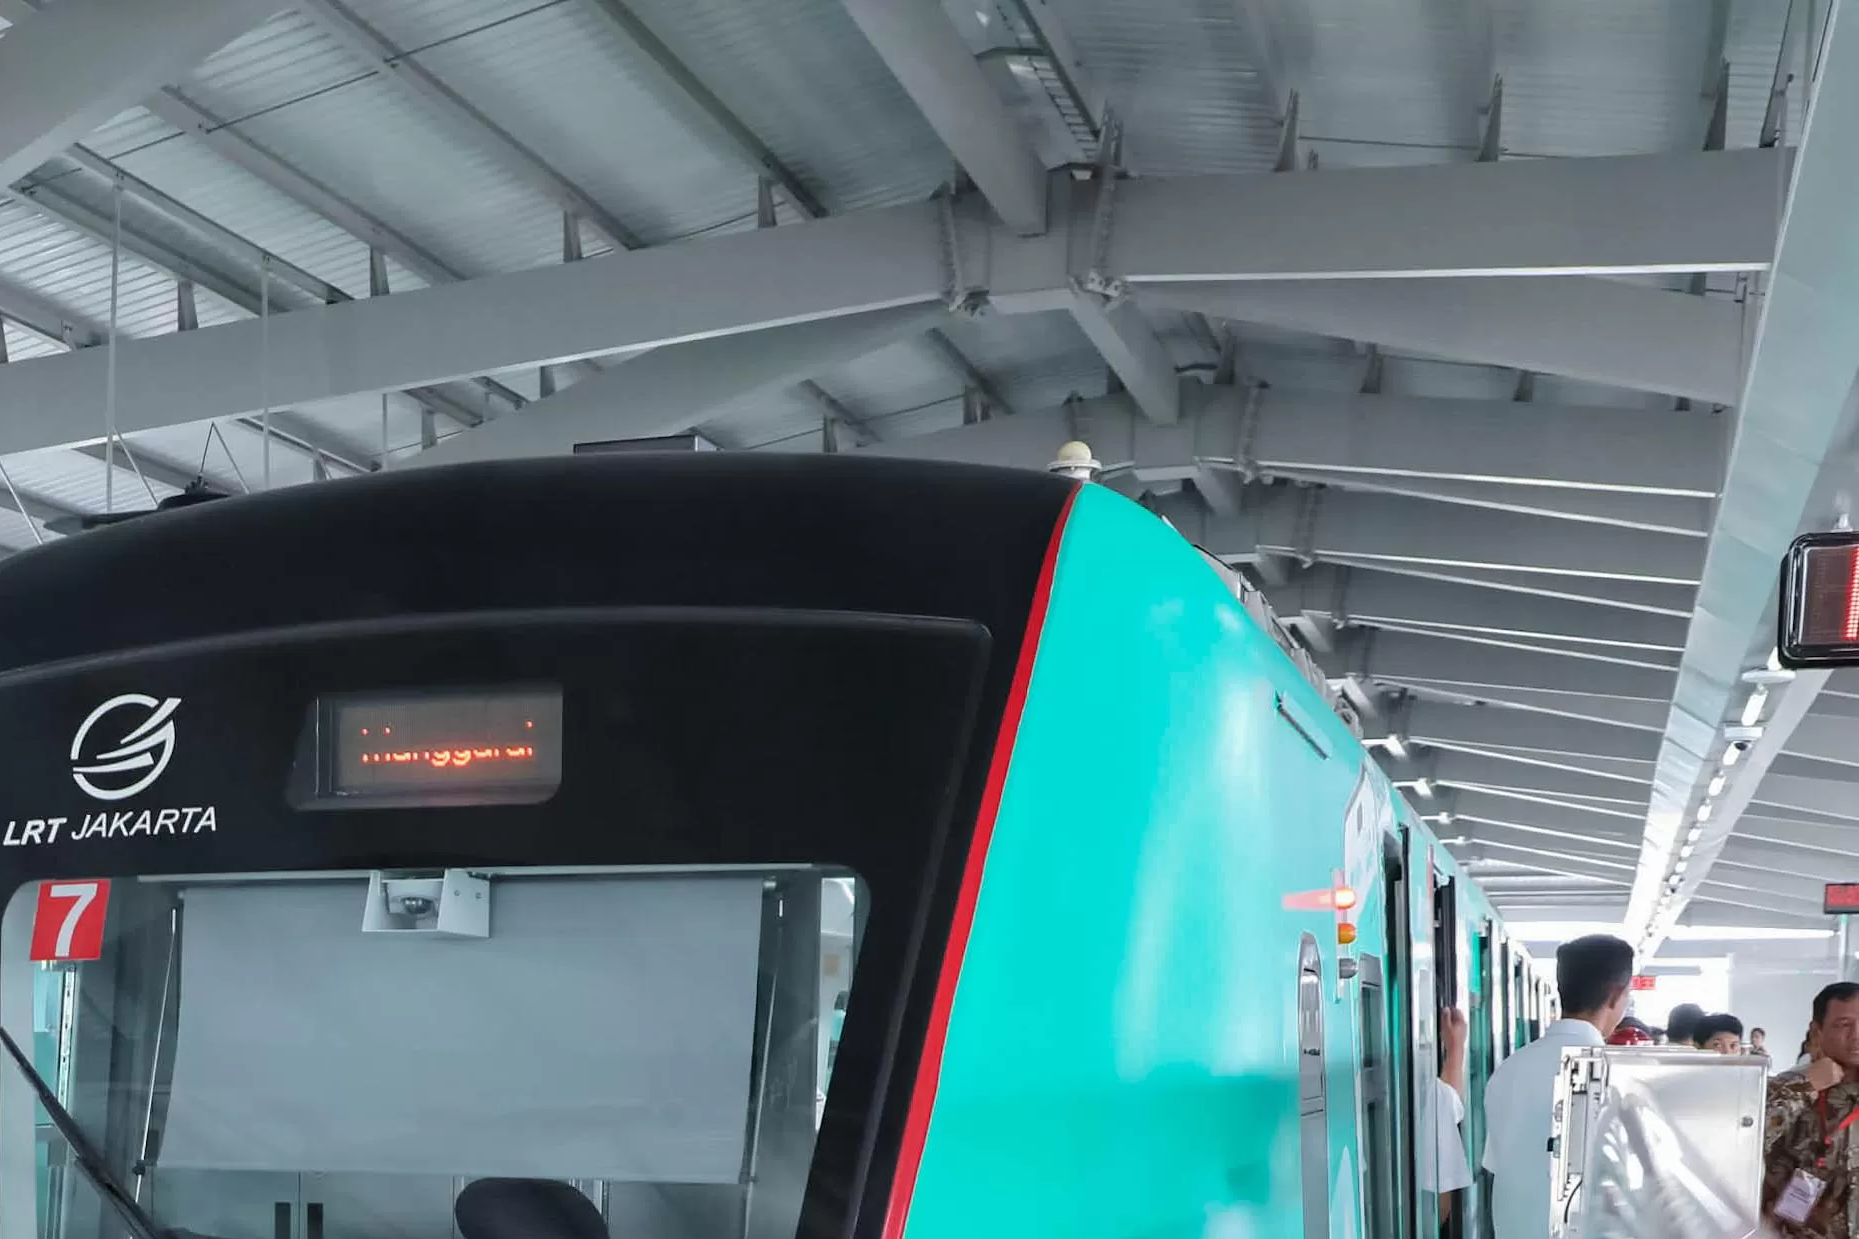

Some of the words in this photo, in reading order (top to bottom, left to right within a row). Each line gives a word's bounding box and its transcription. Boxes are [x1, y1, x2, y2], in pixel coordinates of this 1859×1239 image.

[2, 816, 68, 846] LRT
[71, 806, 217, 840] JAKARTA
[50, 883, 98, 957] 7
